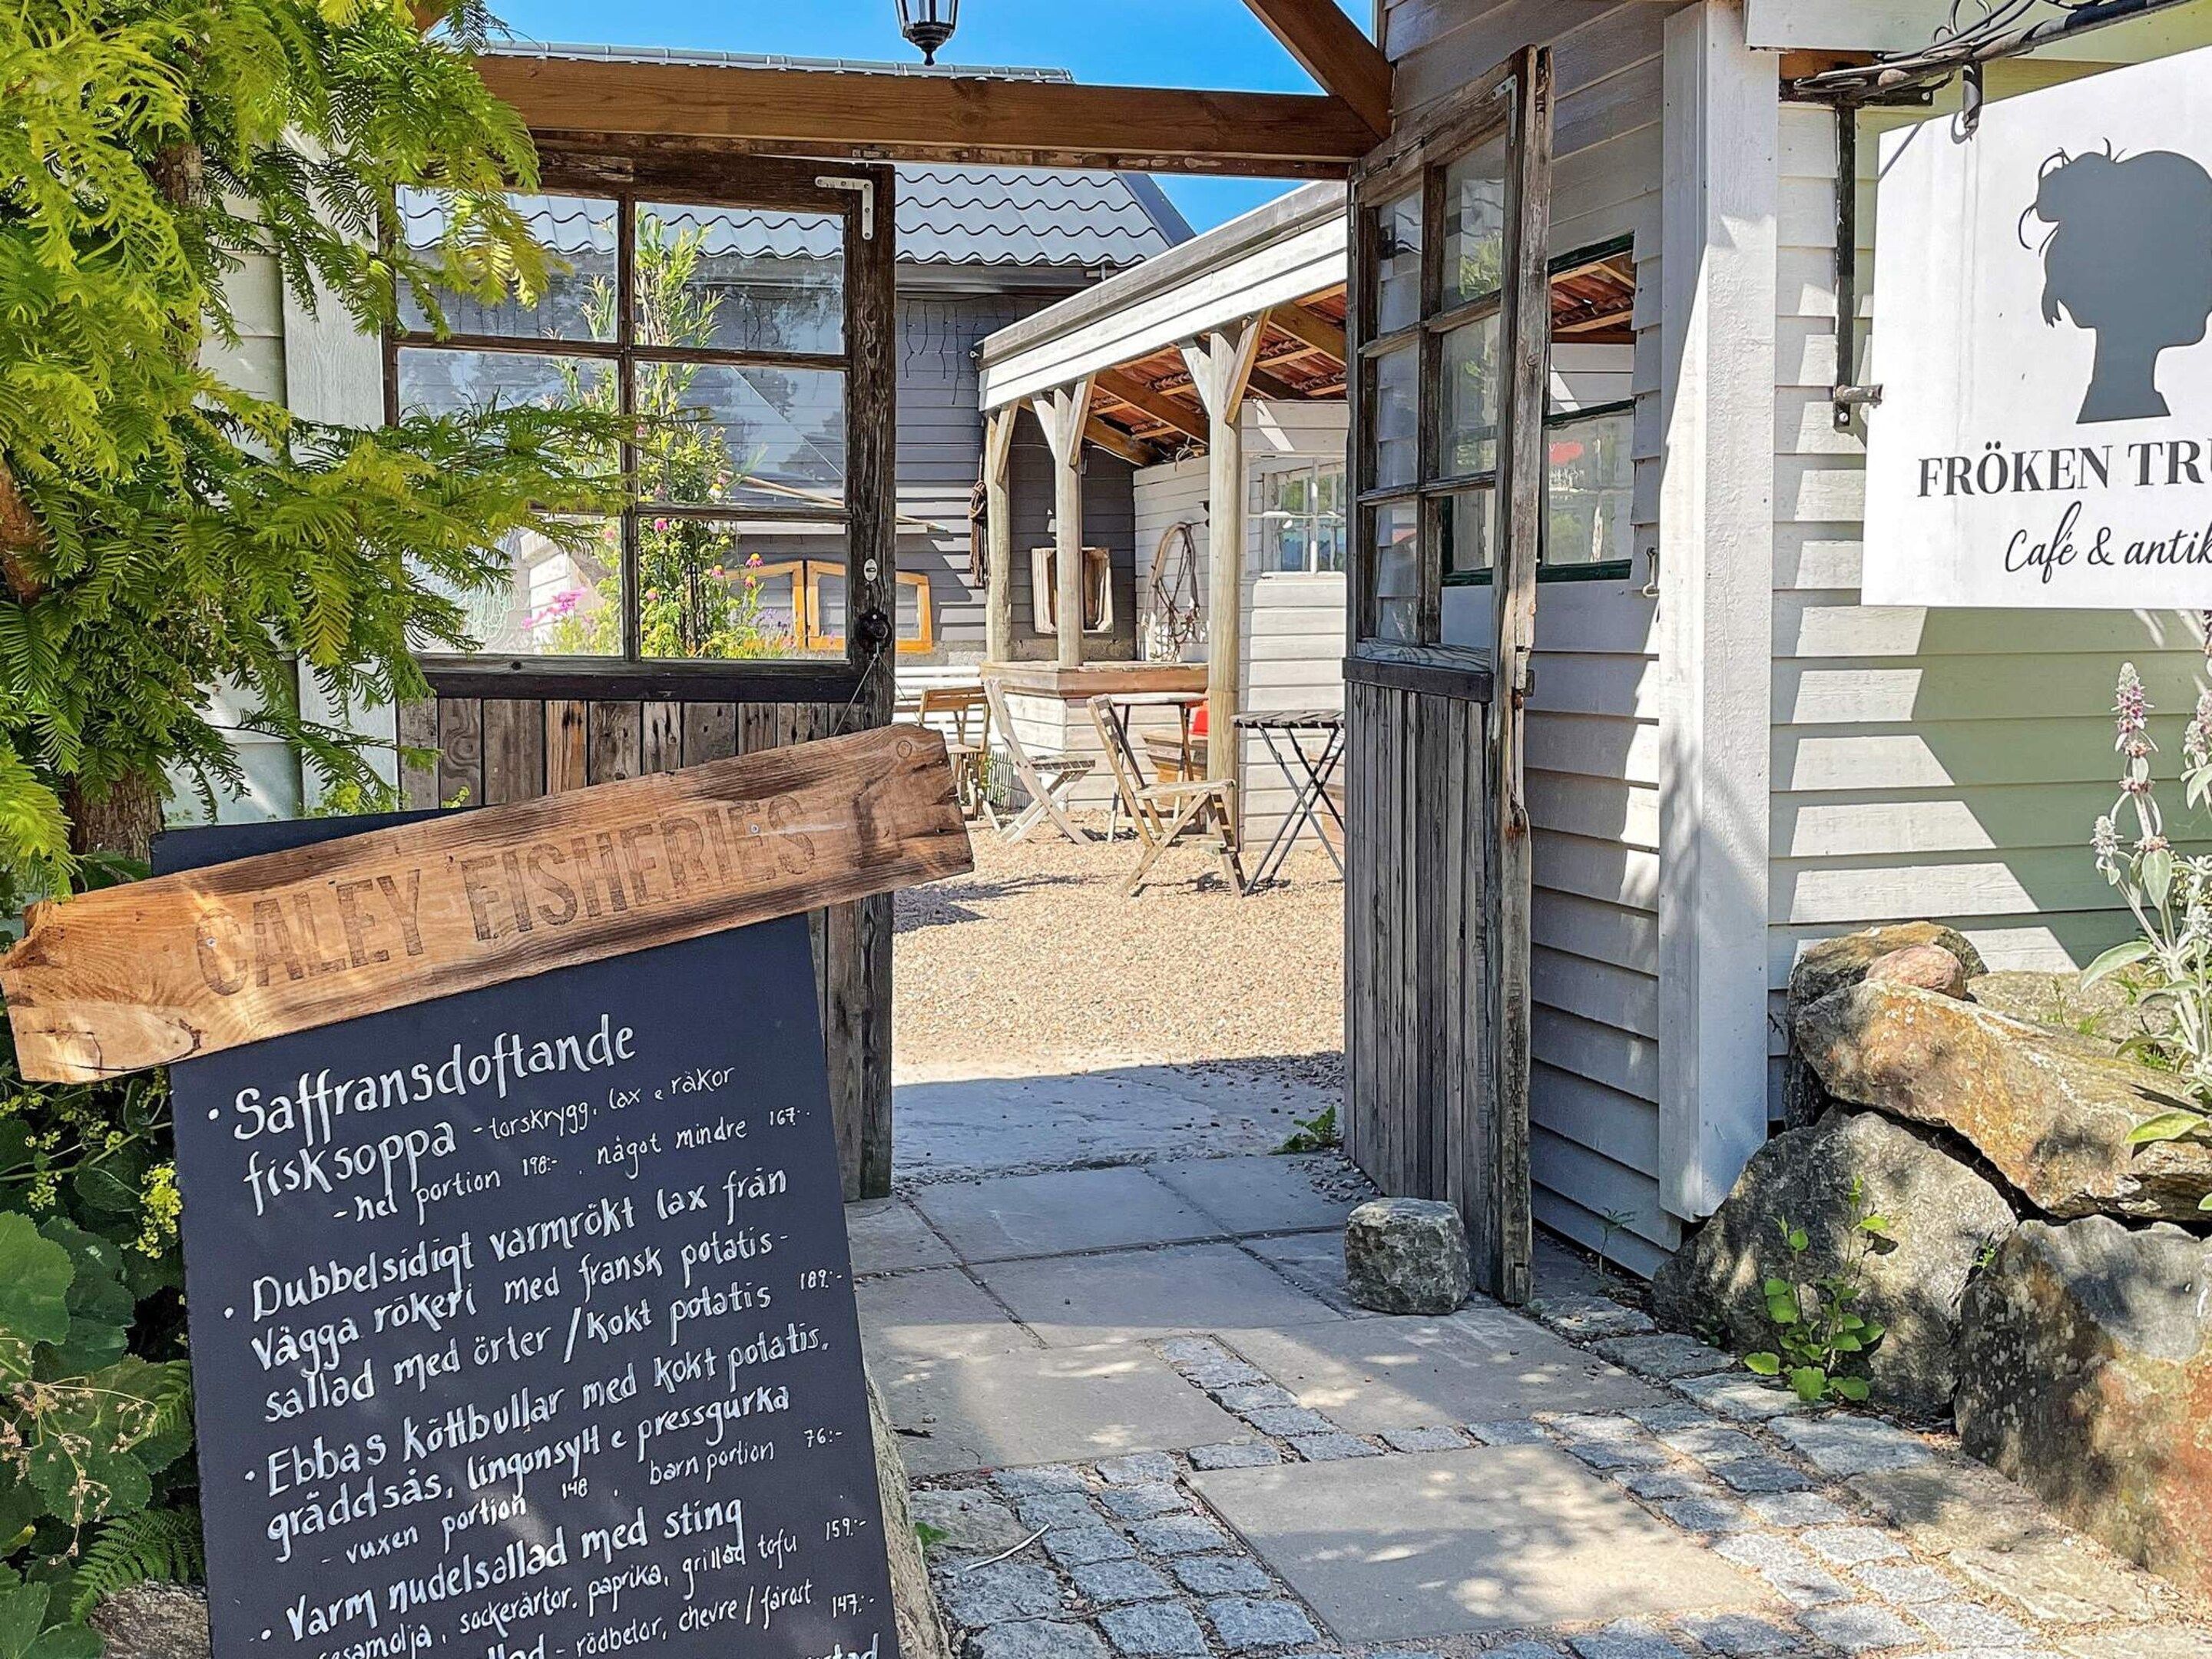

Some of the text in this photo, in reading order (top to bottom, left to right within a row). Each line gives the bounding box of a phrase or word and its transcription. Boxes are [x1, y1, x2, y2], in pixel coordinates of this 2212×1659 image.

[1917, 437, 2212, 498] FRÖKEN TR
[2005, 500, 2082, 584] Café
[2088, 526, 2116, 566] &
[197, 796, 816, 996] CALEY FISHERIES
[233, 1013, 636, 1147] Saffransdoftande
[243, 1121, 458, 1216] fisksoppa
[608, 1088, 641, 1110] lax
[671, 1067, 736, 1096] räkor
[416, 1167, 502, 1226] portion
[597, 1134, 662, 1180] något
[675, 1118, 748, 1150] mindre
[252, 1167, 787, 1323] Dubbelsidigt varmrökt lax från
[373, 1282, 478, 1333] rökeri
[504, 1267, 561, 1304] med
[578, 1245, 664, 1303] fransk
[264, 1357, 376, 1423] sallad
[393, 1337, 461, 1392] med
[473, 1326, 551, 1366] örter
[669, 1281, 772, 1346] potatis
[267, 1433, 388, 1498] Ebbas
[403, 1387, 565, 1462] köttbullar
[582, 1363, 637, 1410] med
[654, 1345, 717, 1394] kokt
[637, 1385, 790, 1462] pressgurka
[286, 1498, 743, 1641] Varm nudelsallad med sting
[345, 1525, 419, 1565] vuxen
[441, 1495, 527, 1554] portion
[561, 1477, 588, 1500] 148
[682, 1542, 747, 1601] grillad
[757, 1528, 797, 1570] tofu
